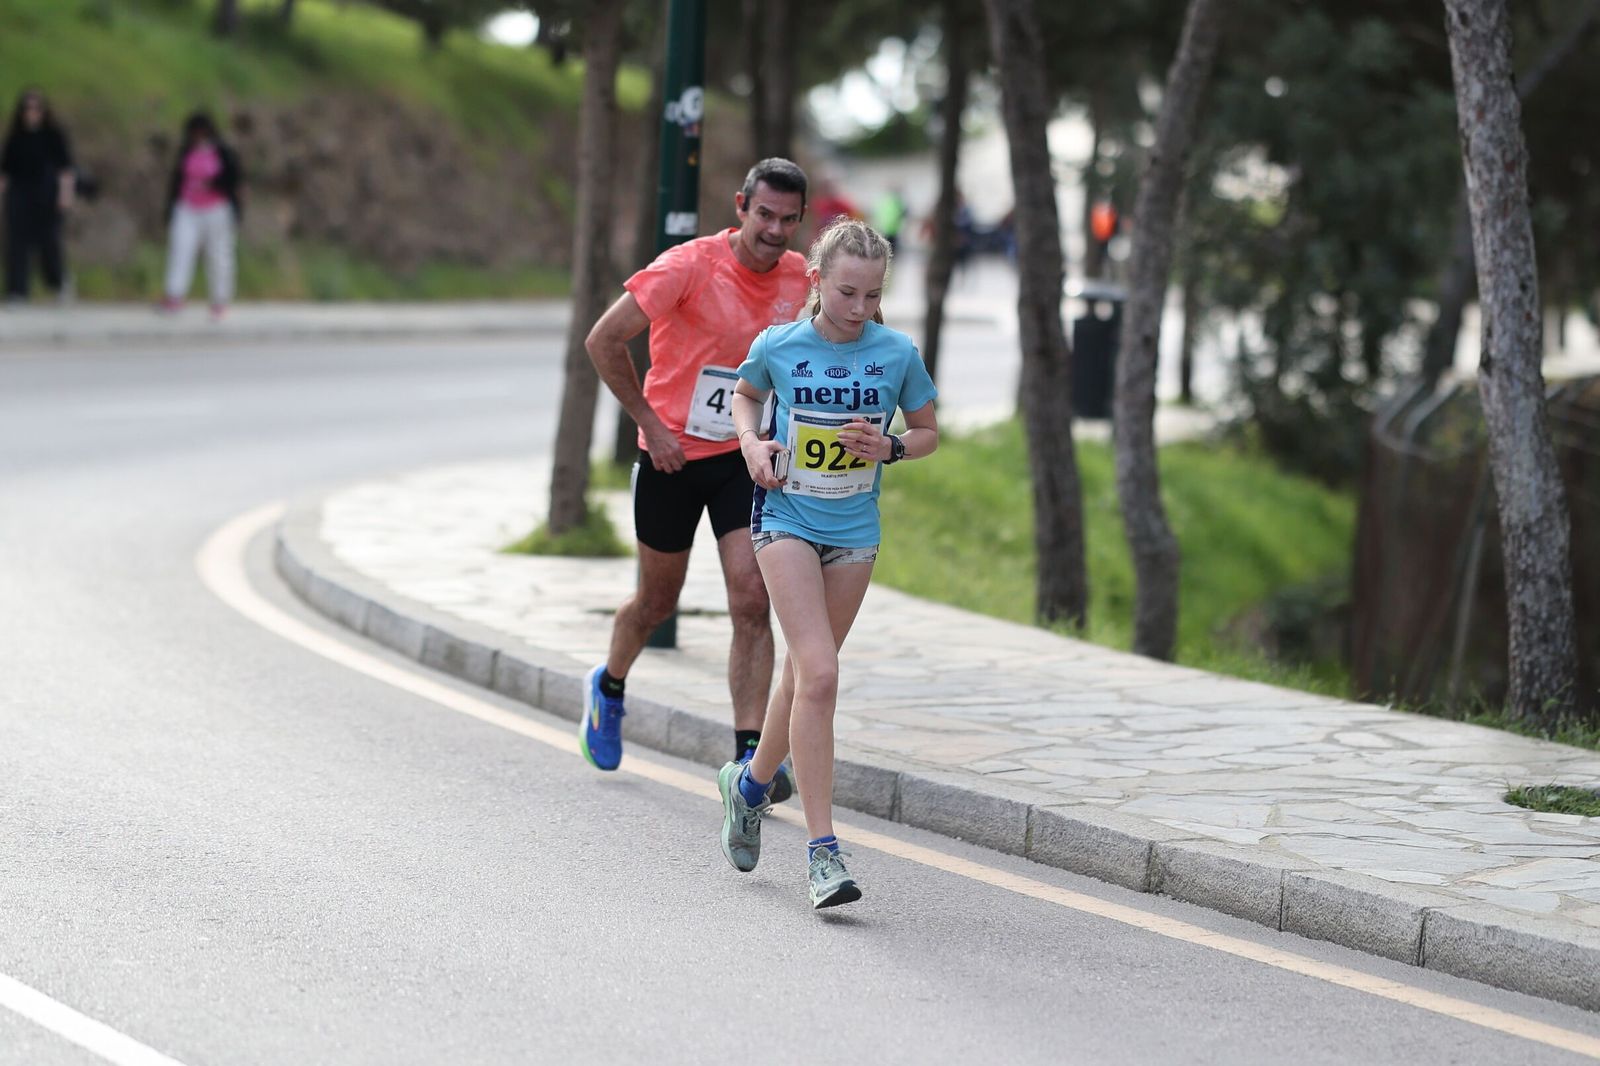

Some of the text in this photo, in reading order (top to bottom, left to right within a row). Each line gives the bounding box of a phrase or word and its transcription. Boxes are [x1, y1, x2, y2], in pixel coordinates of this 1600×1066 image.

[826, 368, 850, 377] TROPS
[706, 388, 735, 417] 4
[793, 380, 880, 411] nerja
